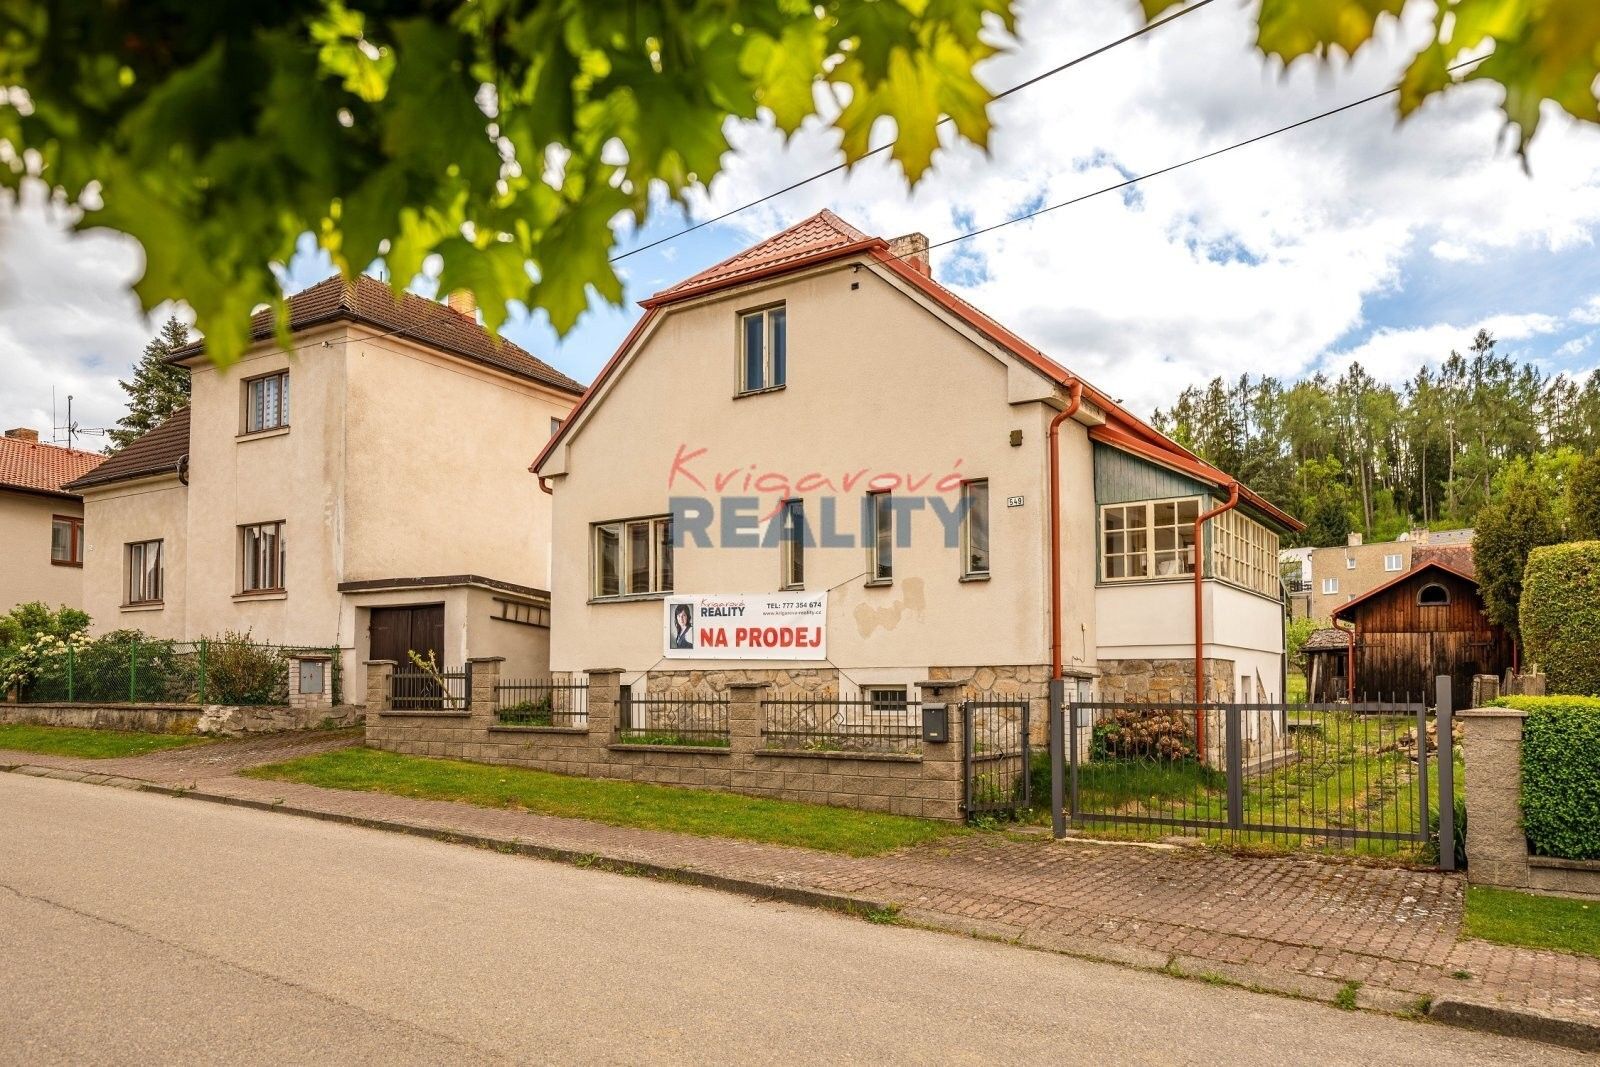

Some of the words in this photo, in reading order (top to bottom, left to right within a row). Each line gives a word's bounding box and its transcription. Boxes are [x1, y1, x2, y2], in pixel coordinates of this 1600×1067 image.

[1009, 497, 1022, 505] 549
[700, 606, 745, 617] REALITY
[700, 627, 728, 648] NA
[735, 627, 822, 648] PRODEJ
